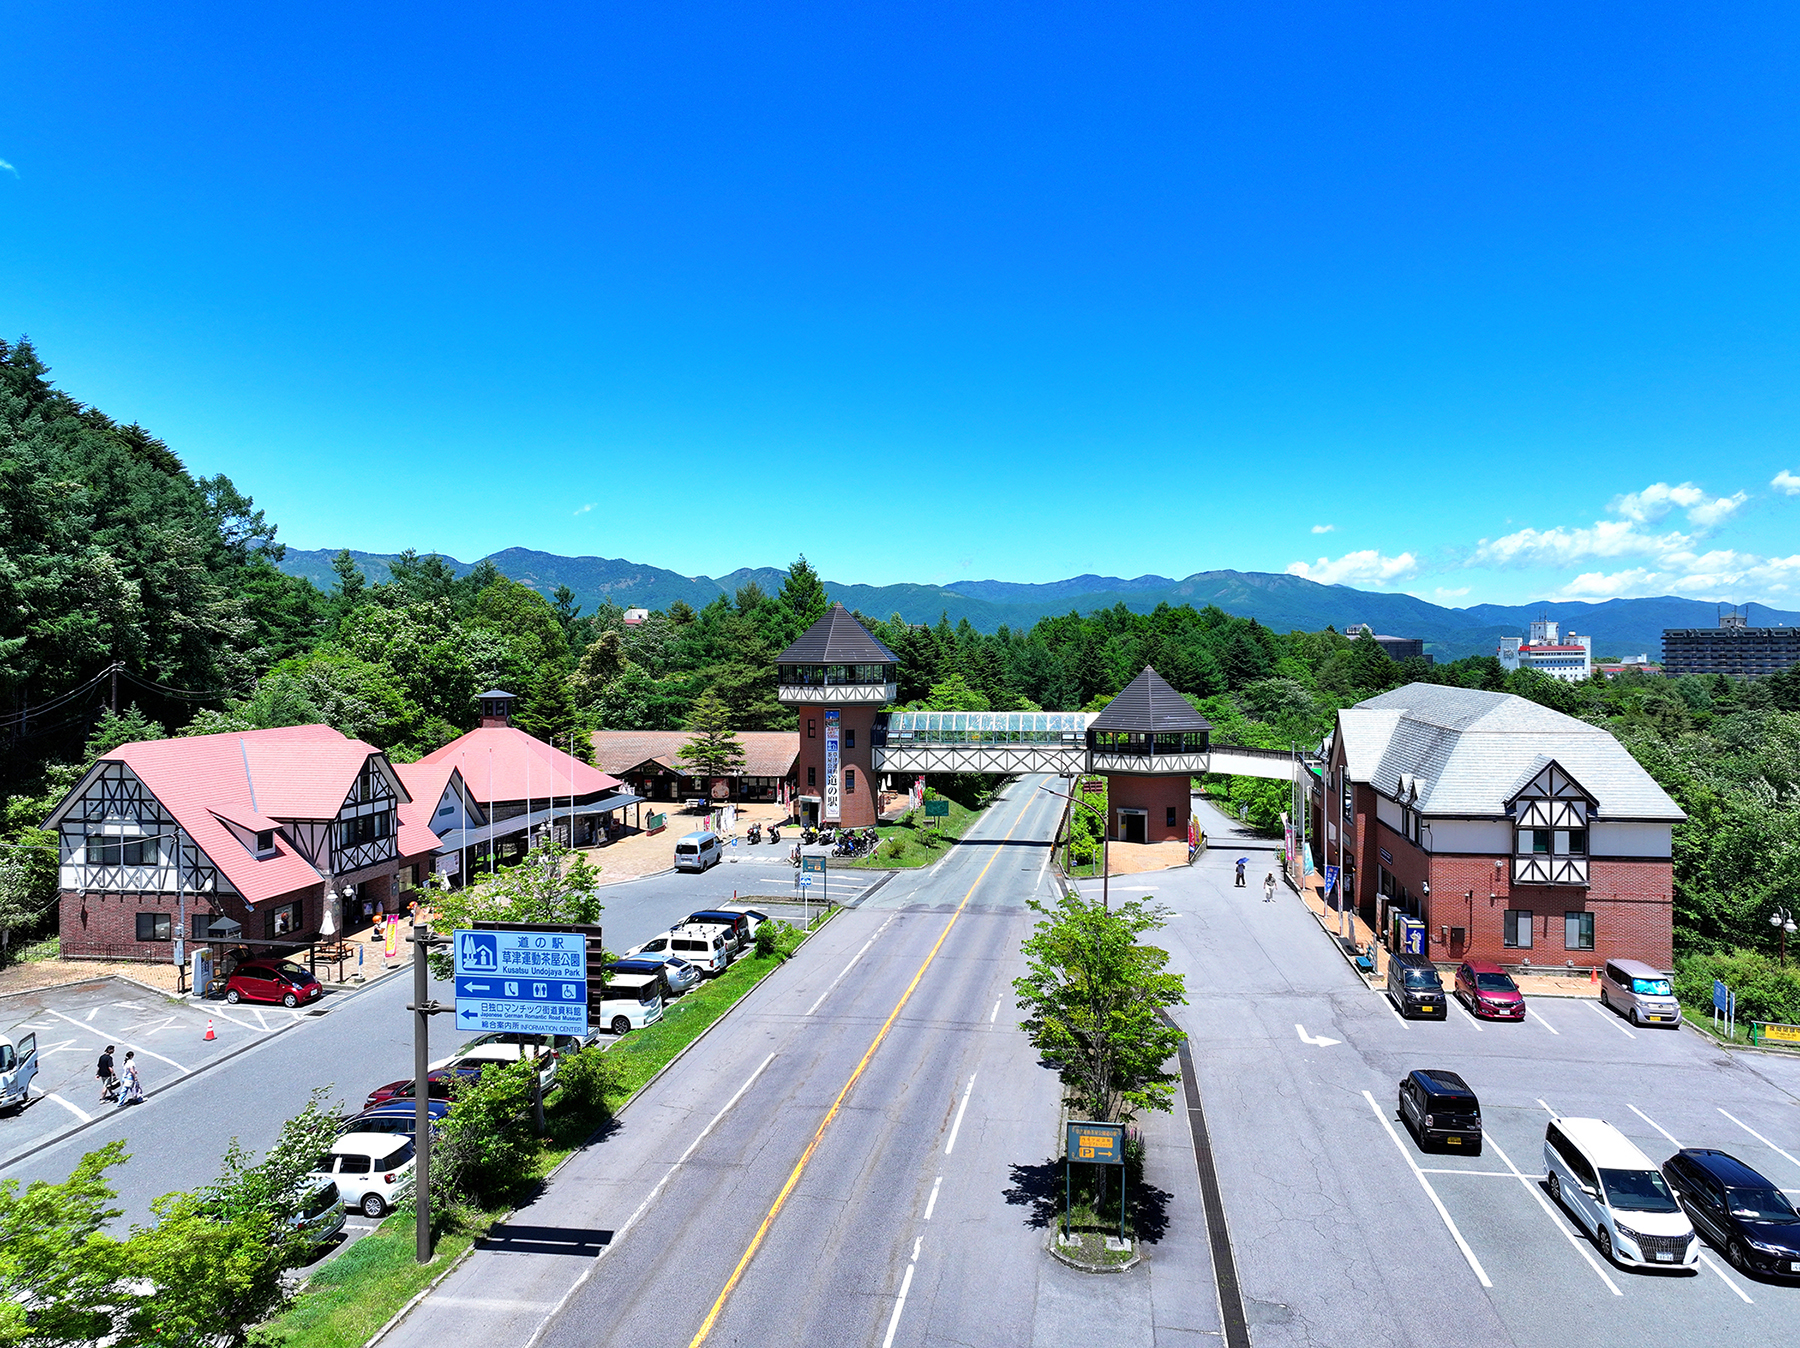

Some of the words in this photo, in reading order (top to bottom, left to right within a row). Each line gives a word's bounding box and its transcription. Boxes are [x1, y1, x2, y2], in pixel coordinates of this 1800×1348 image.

[827, 774, 838, 807] 道の駅
[517, 936, 564, 949] 道の駅
[502, 950, 581, 967] 草津運動茶屋公園
[502, 966, 529, 974] Kusatsu
[531, 967, 562, 977] Undojaya
[564, 968, 581, 976] Park
[481, 1021, 520, 1030] 総合案内所
[521, 1023, 558, 1032] INFORMATION
[559, 1025, 582, 1033] CENTER
